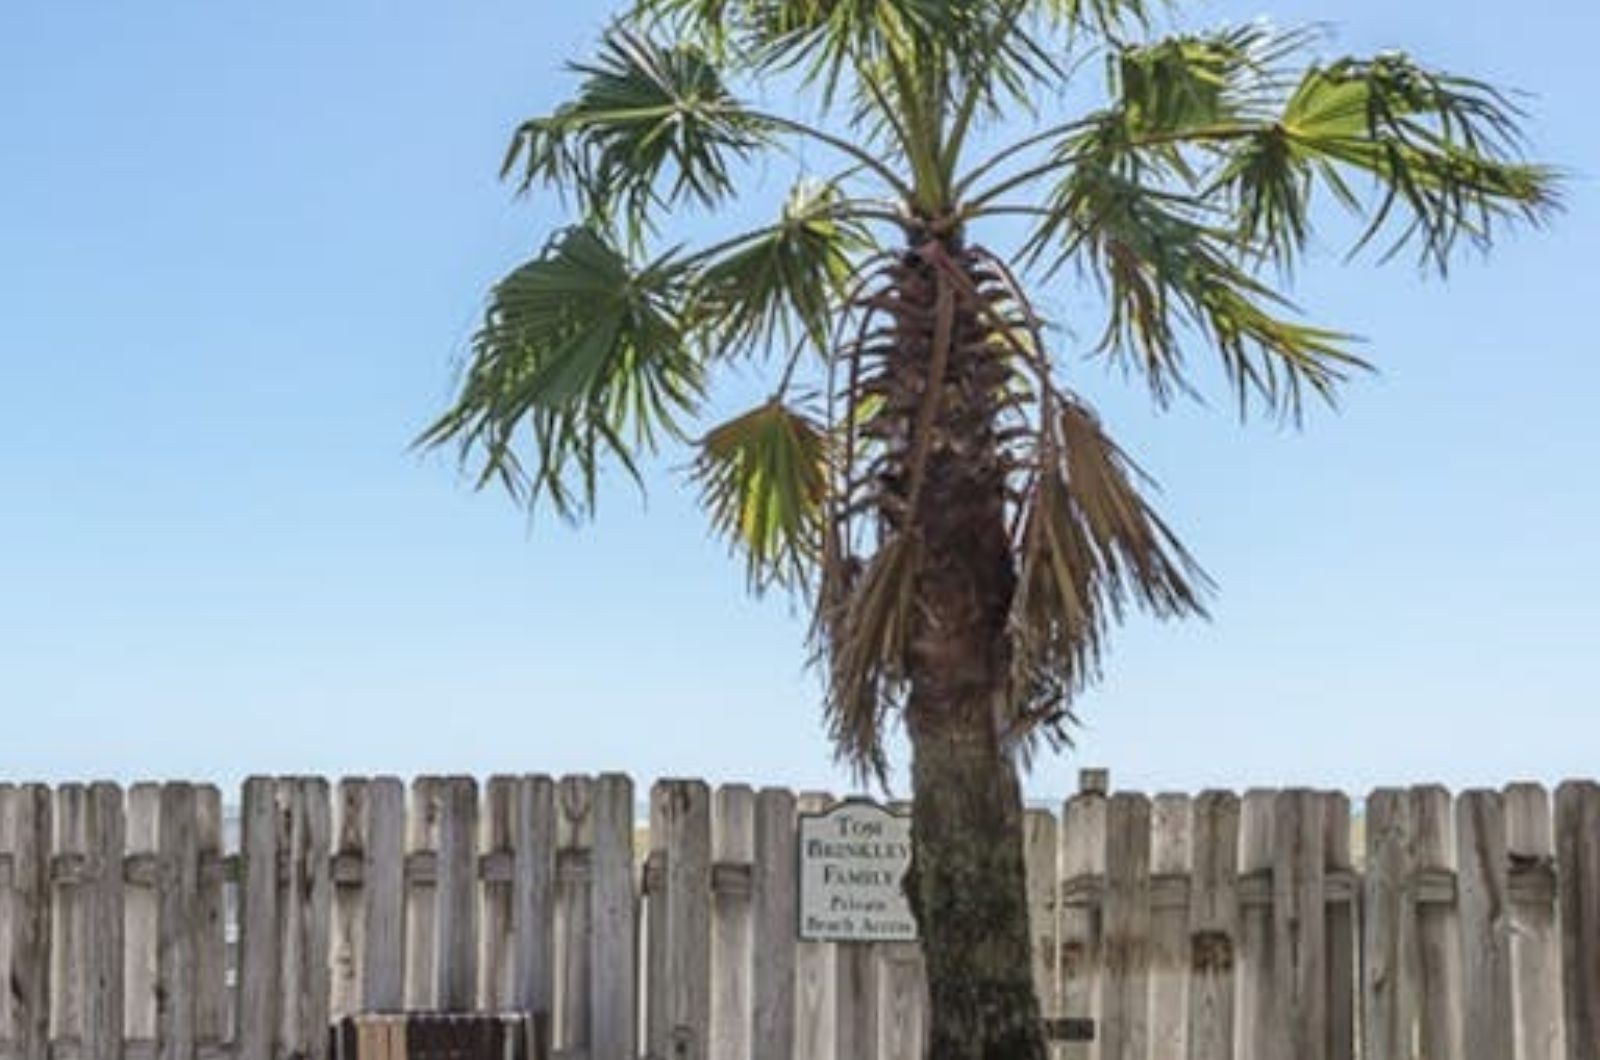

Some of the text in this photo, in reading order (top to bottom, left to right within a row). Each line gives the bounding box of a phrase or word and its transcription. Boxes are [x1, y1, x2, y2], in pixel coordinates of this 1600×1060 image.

[824, 865, 893, 885] FAMILY
[831, 895, 886, 911] Private
[807, 916, 853, 931] Beach
